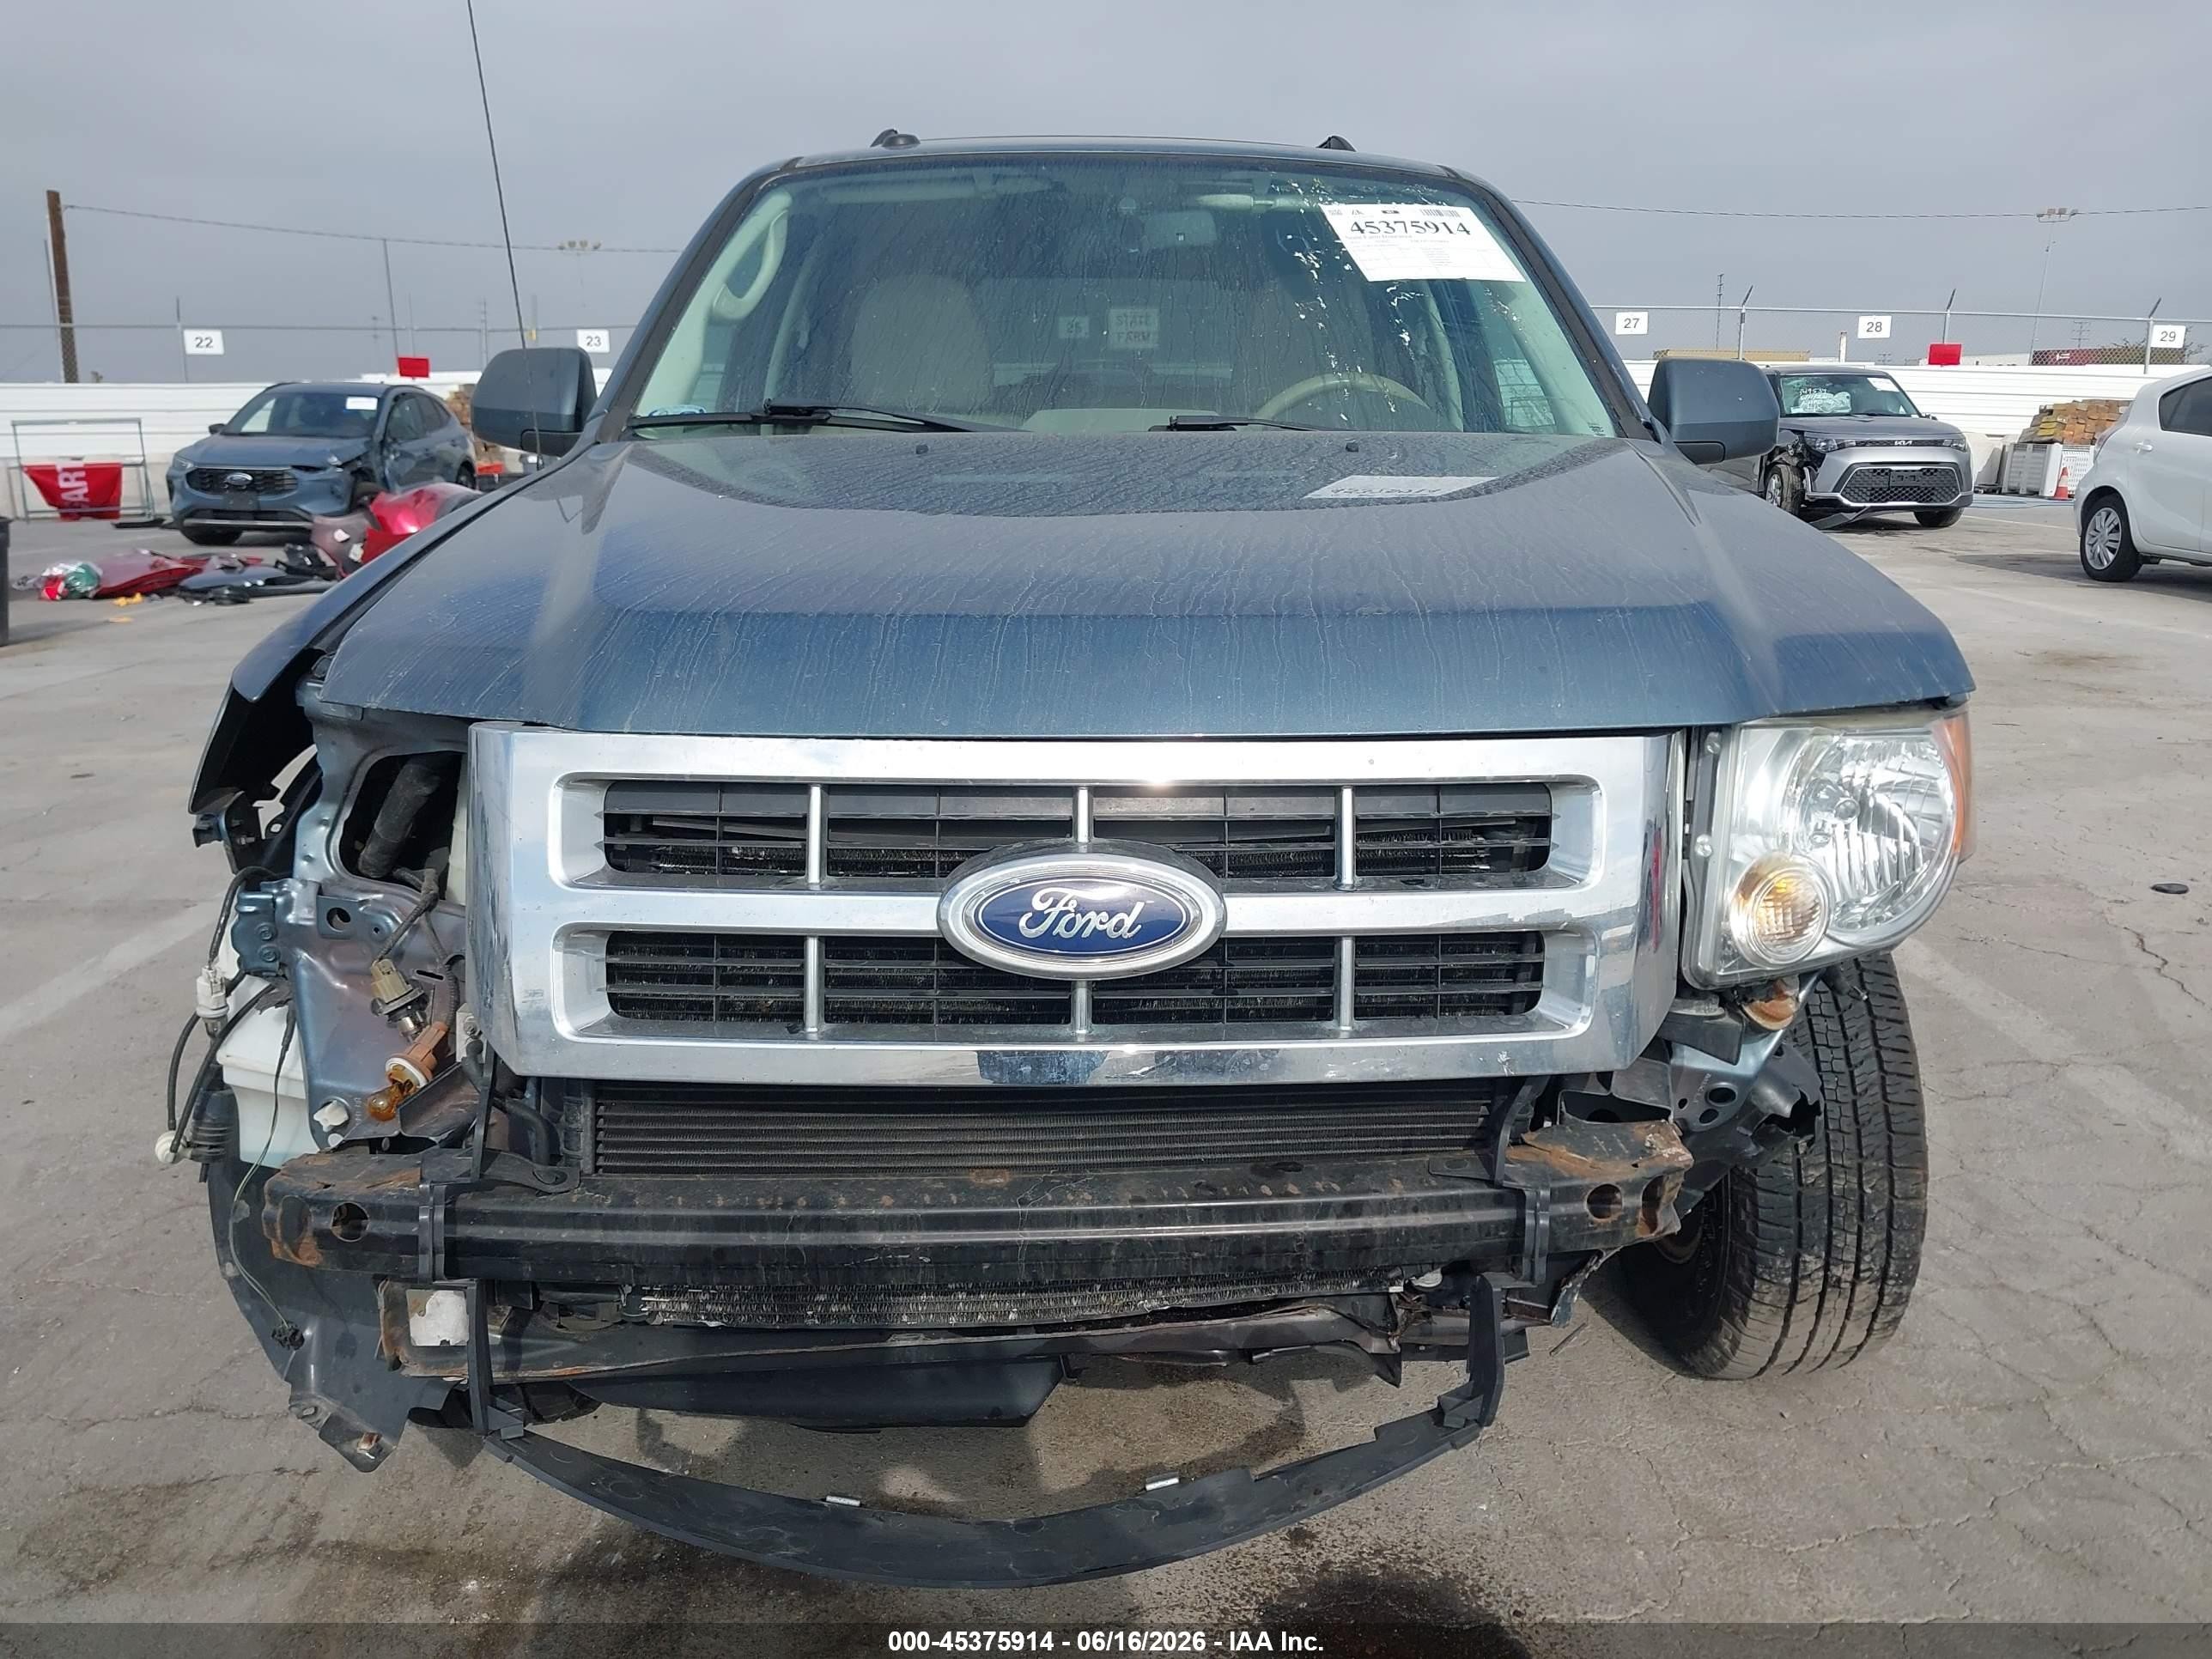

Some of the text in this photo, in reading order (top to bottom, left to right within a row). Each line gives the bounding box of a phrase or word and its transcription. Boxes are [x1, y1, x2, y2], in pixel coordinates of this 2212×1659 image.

[1350, 221, 1471, 236] 45375914
[1624, 318, 1640, 329] 27
[1866, 321, 1882, 332] 28
[586, 336, 602, 347] 23
[2160, 331, 2176, 342] 29
[195, 336, 213, 349] 22
[1018, 886, 1146, 939] Ford
